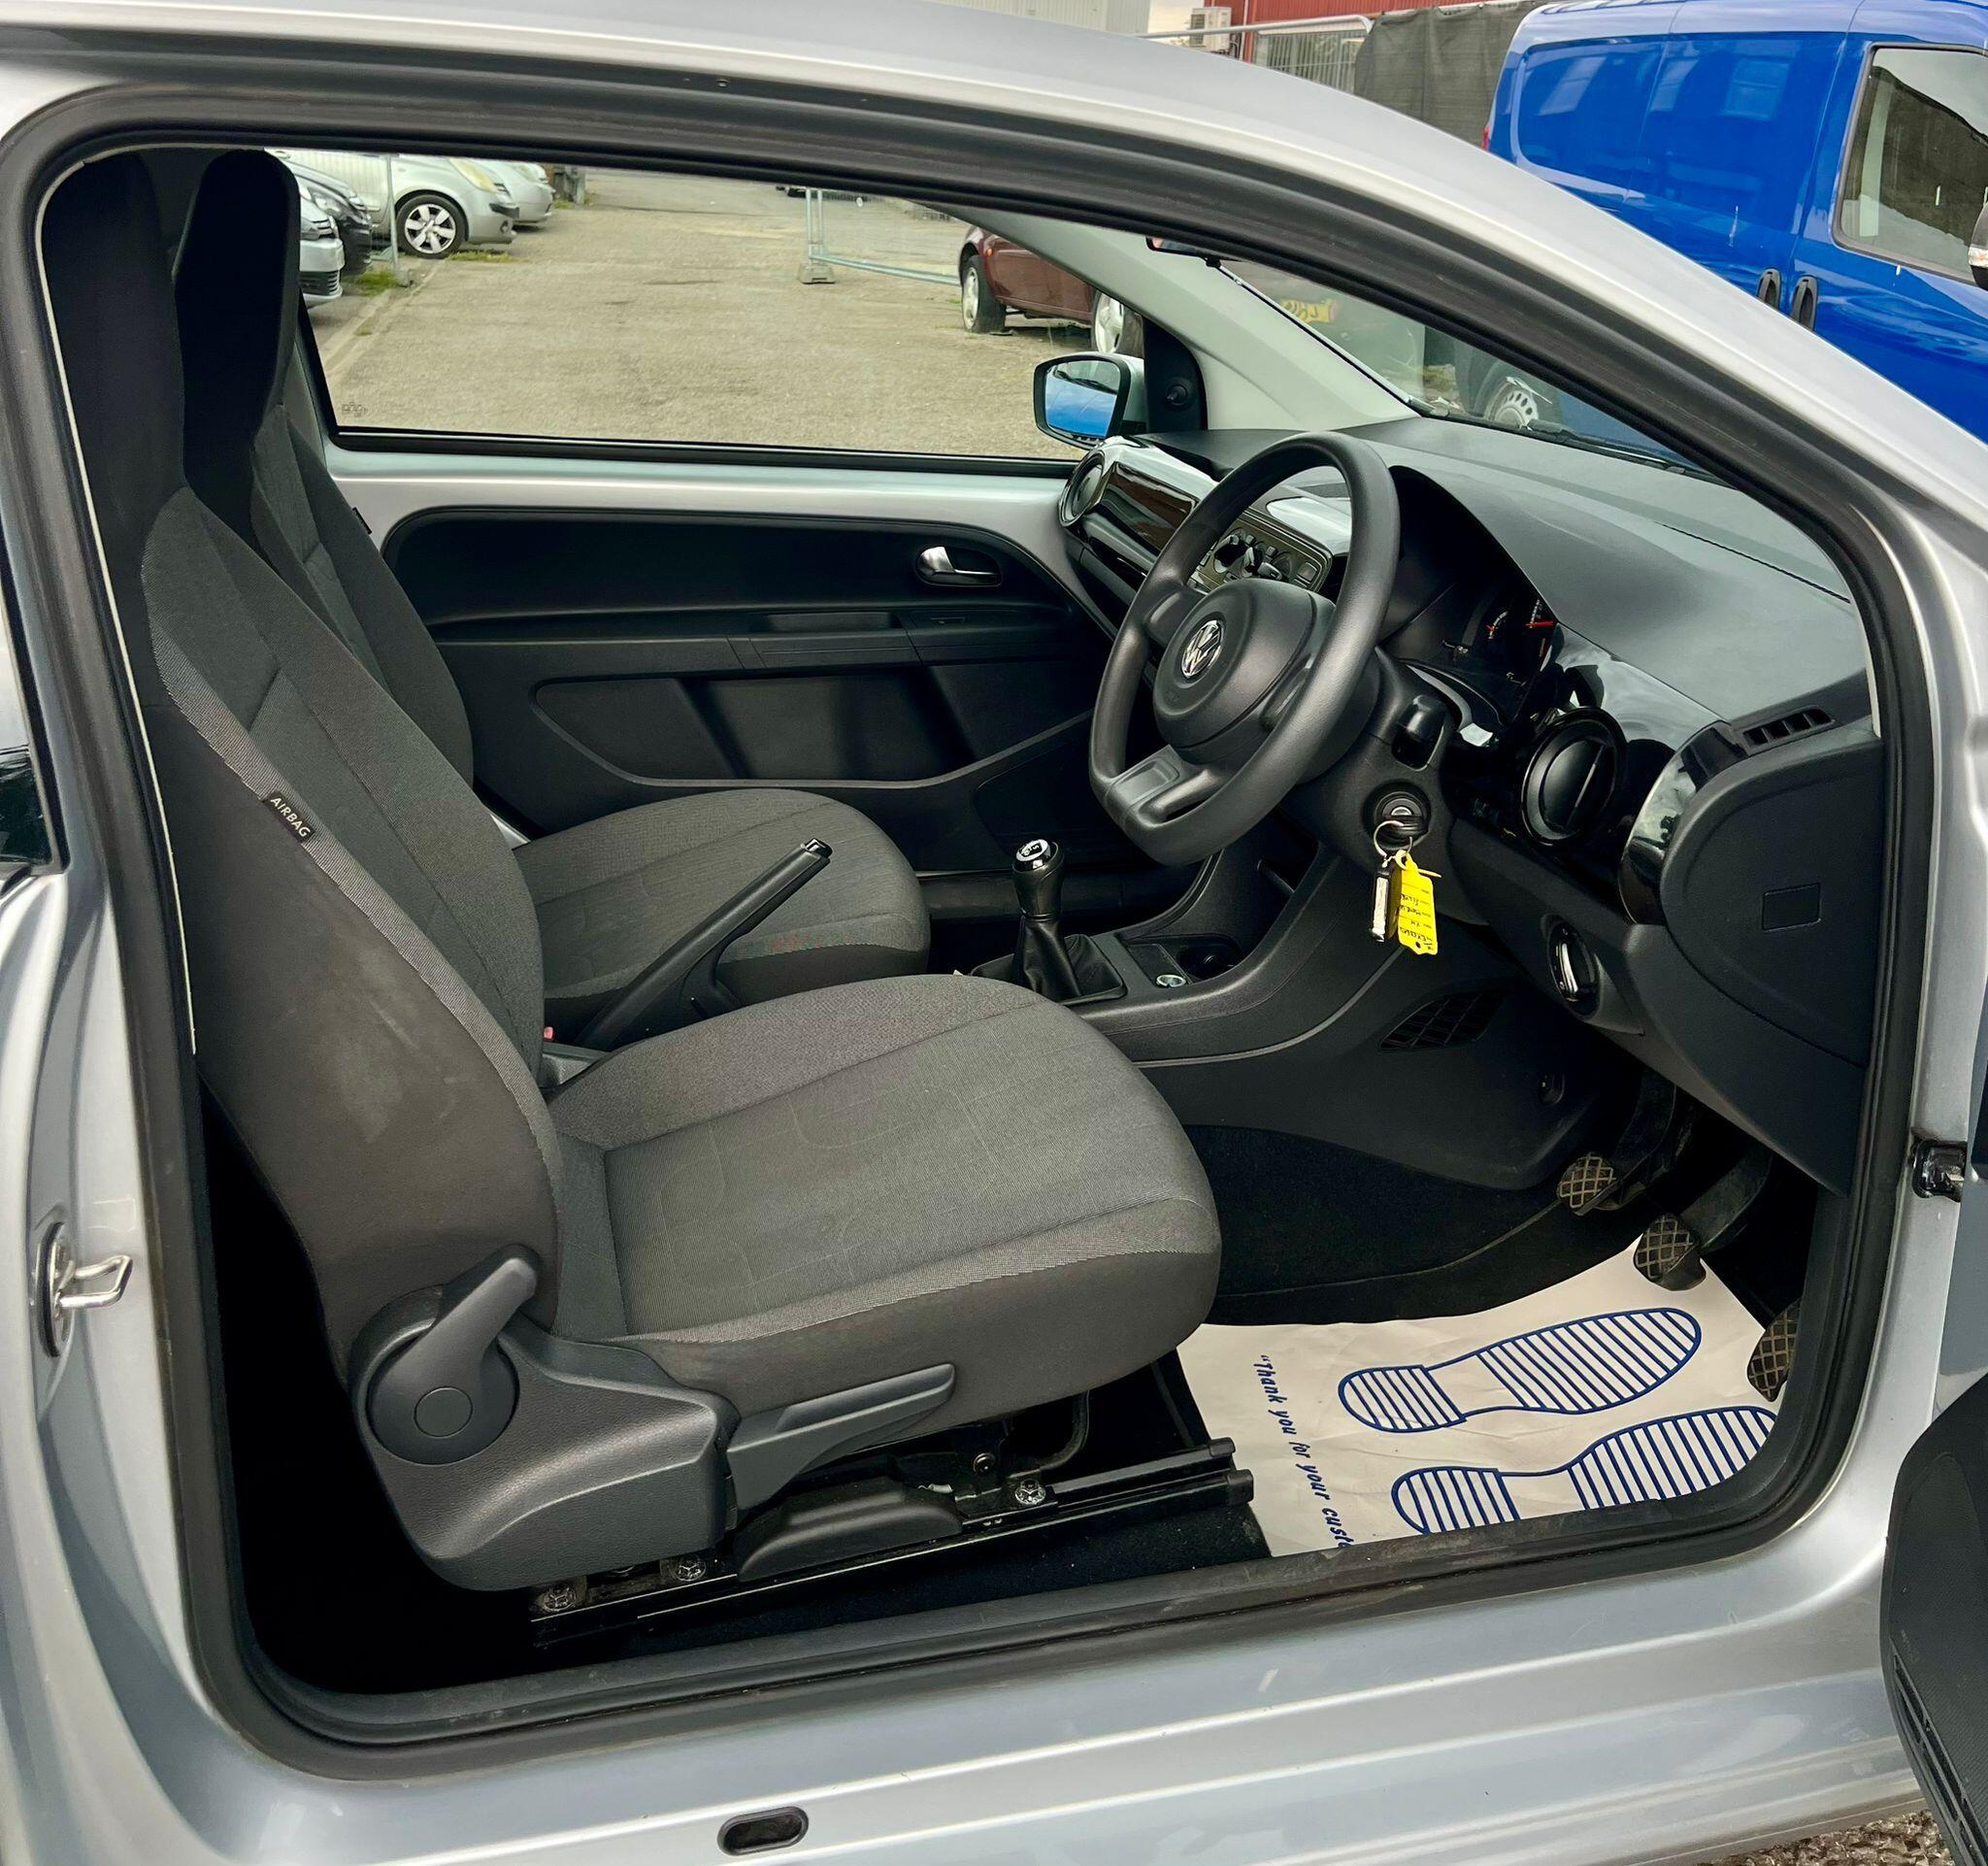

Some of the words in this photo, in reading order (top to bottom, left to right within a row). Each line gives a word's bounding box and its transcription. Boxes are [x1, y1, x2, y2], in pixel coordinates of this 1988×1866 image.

[270, 797, 311, 837] AIRBAG
[1267, 1409, 1297, 1435] you
[1288, 1441, 1310, 1458] for
[1295, 1463, 1331, 1500] your
